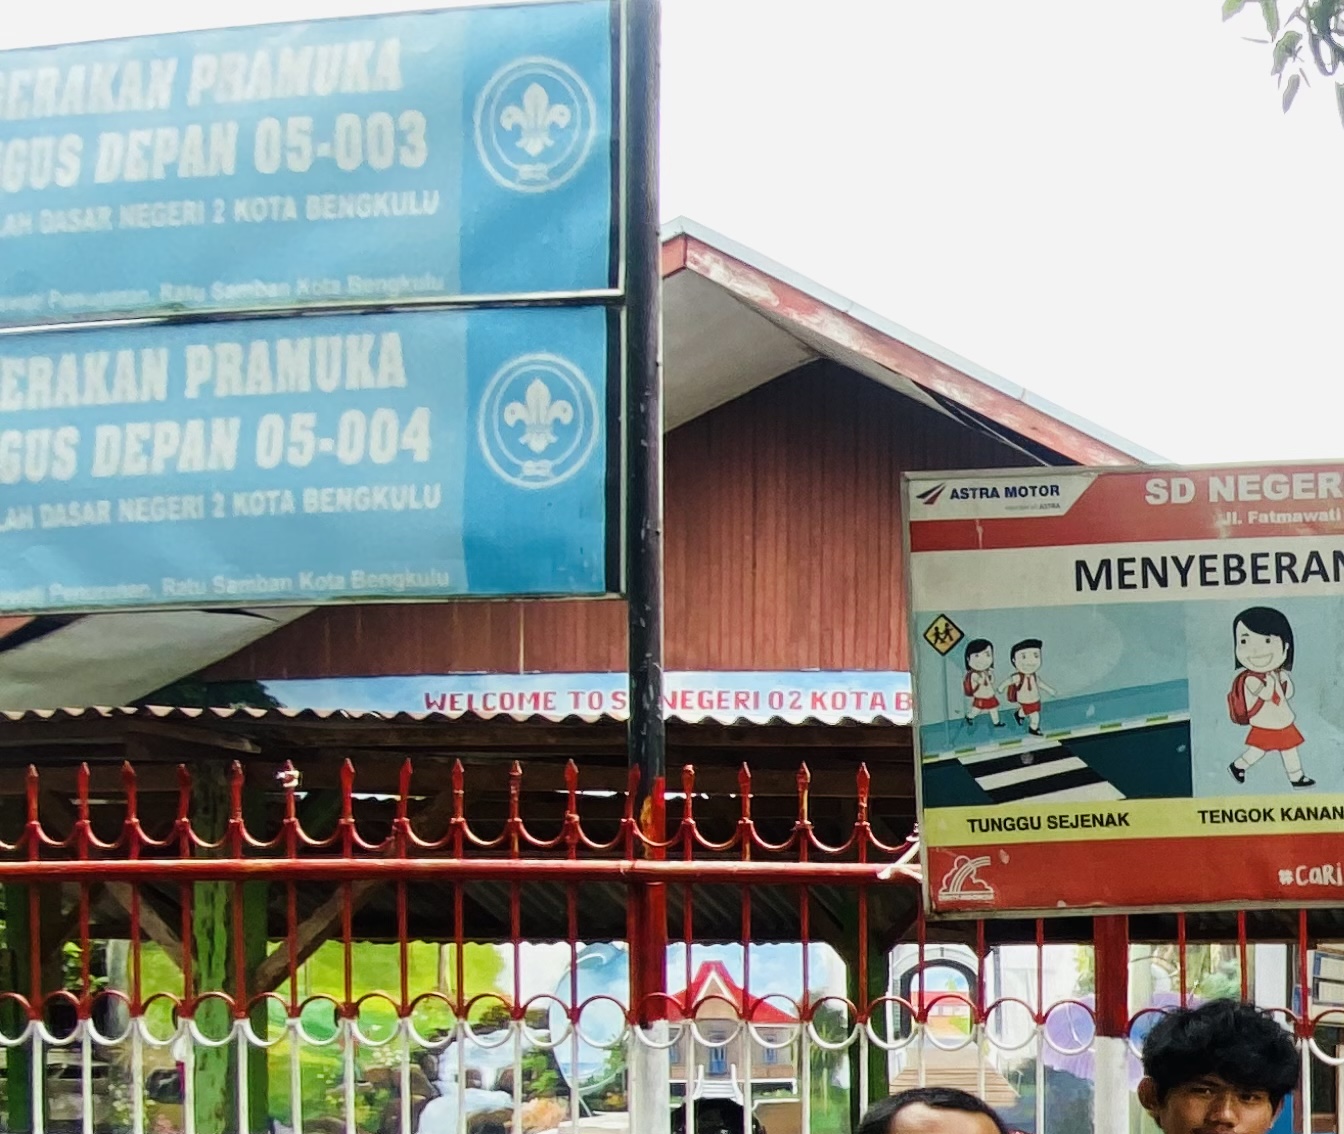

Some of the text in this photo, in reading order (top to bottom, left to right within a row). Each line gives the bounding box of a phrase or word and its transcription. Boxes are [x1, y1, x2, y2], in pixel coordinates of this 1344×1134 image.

[0, 38, 404, 121] ERAKAN PRAMUKA
[0, 110, 429, 193] GUS DEPAN 05-003
[40, 205, 112, 234] DASAR
[119, 199, 206, 228] NEGERI
[212, 198, 225, 224] 2
[234, 195, 297, 223] KOTA
[306, 189, 441, 221] BENGKULU
[0, 332, 407, 411] ERAKAN PRAMUKA
[0, 406, 432, 485] GUS DEPAN 05-004
[40, 499, 111, 529] DASAR
[118, 494, 205, 522] NEGERI
[212, 491, 225, 518] 2
[233, 489, 296, 518] KOTA
[303, 483, 442, 513] BENGKULU
[950, 484, 1060, 500] ASTRA MOTOR
[1144, 477, 1196, 506] SD
[1248, 509, 1342, 526] Fatmawati
[299, 571, 345, 591] Kota
[351, 569, 449, 593] Bengkulu
[425, 690, 557, 712] WELCOME
[569, 690, 604, 711] TO
[662, 688, 760, 711] NEGERI
[768, 689, 802, 711] 02
[810, 690, 887, 712] KOTA
[967, 811, 1130, 834] TUNGGU SEJENAK
[1198, 807, 1275, 825] TENGOK
